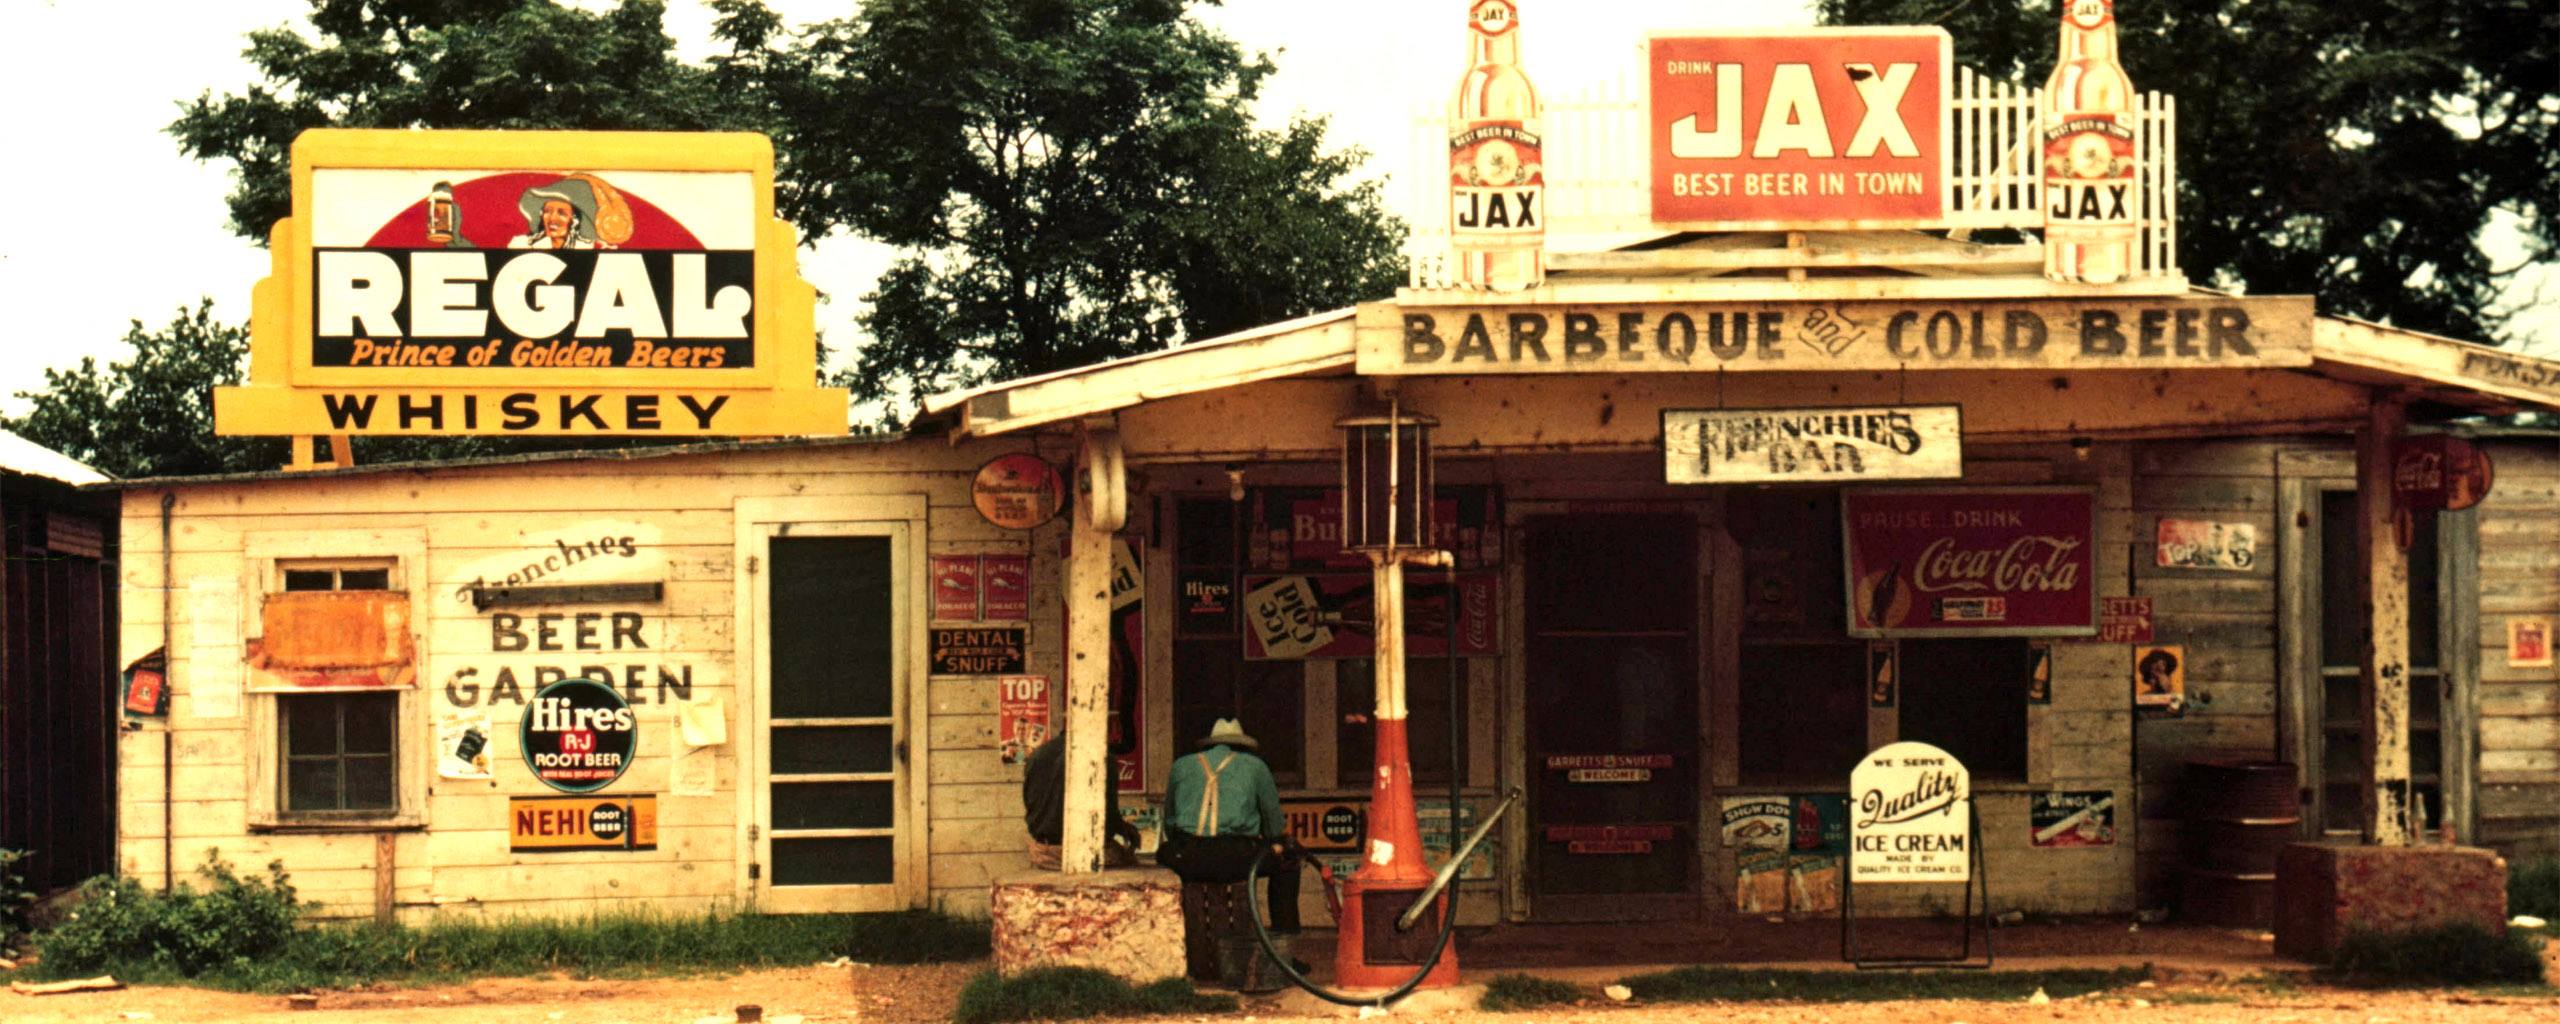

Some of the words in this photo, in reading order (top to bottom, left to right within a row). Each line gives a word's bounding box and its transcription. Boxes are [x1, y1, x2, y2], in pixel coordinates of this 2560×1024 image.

[1483, 9, 1505, 21] JAX
[2078, 4, 2099, 16] JAX
[1667, 61, 1713, 75] DRINK
[1670, 62, 1922, 159] JAX
[1454, 130, 1476, 147] BEST
[1476, 126, 1502, 139] BEER
[1503, 127, 1514, 138] IN
[1514, 130, 1539, 146] TOWN
[2048, 125, 2070, 140] BEST
[2070, 120, 2095, 133] BEER
[2107, 123, 2131, 139] TOWN
[1673, 172, 1735, 197] BEST
[1744, 172, 1808, 196] BEER
[1819, 172, 1845, 196] IN
[1854, 172, 1923, 196] TOWN
[1459, 191, 1536, 229] JAX
[2052, 184, 2127, 220] JAX
[318, 250, 753, 339] REGAL
[1402, 311, 1786, 366] BARBEQUE
[1803, 308, 1866, 358] and
[1886, 308, 2049, 359] COLD
[2080, 306, 2258, 357] BEER
[350, 339, 456, 367] Prince
[467, 339, 502, 367] of
[510, 338, 613, 367] Golden
[625, 339, 726, 367] Beers
[321, 392, 731, 431] WHISKEY
[1699, 410, 1922, 476] FRENCHIES
[1769, 440, 1865, 474] BAR
[1859, 511, 1932, 529] PAUSE
[1953, 510, 2023, 529] DRINK
[1914, 534, 2084, 592] Coca-Cola
[2158, 540, 2198, 566] TOP
[1186, 581, 1229, 596] Hires
[1273, 581, 1319, 645] Cold
[1466, 582, 1488, 649] Coca-Cola
[2100, 600, 2150, 614] RETTS
[491, 612, 650, 652] BEER
[1259, 599, 1291, 648] Ice
[2102, 624, 2138, 641] UFF
[938, 630, 1018, 648] DENTAL
[946, 657, 1009, 673] SNUFF
[445, 664, 692, 709] GARDEN
[1003, 679, 1045, 700] TOP
[531, 697, 633, 732] Hires
[565, 733, 592, 750] R-J
[535, 753, 582, 768] ROOT
[585, 753, 622, 767] BEER
[1874, 758, 1893, 767] WE
[1902, 758, 1945, 767] SERVE
[1583, 770, 1636, 780] WELCOME
[1857, 769, 1962, 829] Quality
[2045, 792, 2092, 808] WINGS
[516, 808, 584, 837] NEHI
[592, 810, 621, 821] ROOT
[1326, 814, 1353, 823] ROOT
[1725, 804, 1762, 822] SHOW
[592, 822, 621, 832] BEER
[1285, 811, 1318, 838] HI
[1326, 826, 1353, 835] BEER
[1856, 834, 1889, 852] ICE
[1895, 834, 1964, 852] CREAM
[1886, 855, 1912, 863] MADE
[1921, 855, 1935, 863] BY
[1857, 865, 1892, 875] QUALITY
[1897, 865, 1911, 874] ICE
[1915, 865, 1946, 874] CREAM
